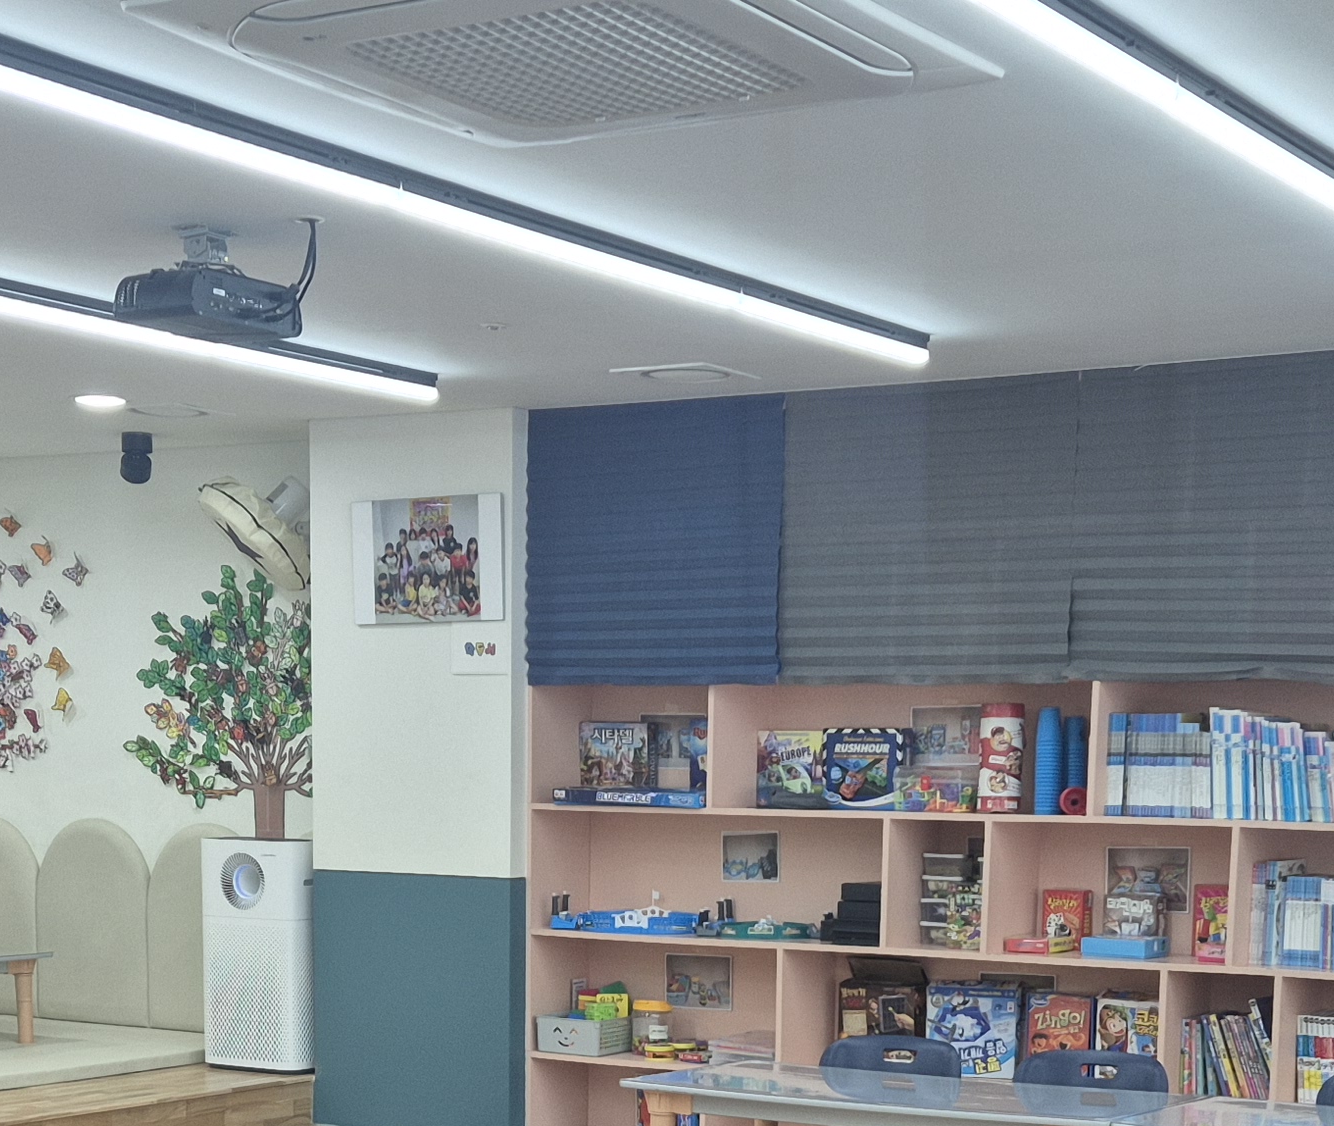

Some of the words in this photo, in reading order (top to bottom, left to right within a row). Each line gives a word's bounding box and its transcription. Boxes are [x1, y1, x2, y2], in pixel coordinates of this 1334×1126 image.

[591, 728, 634, 745] 시타델
[780, 745, 812, 762] EUROPE
[1034, 1009, 1085, 1030] Zingo!
